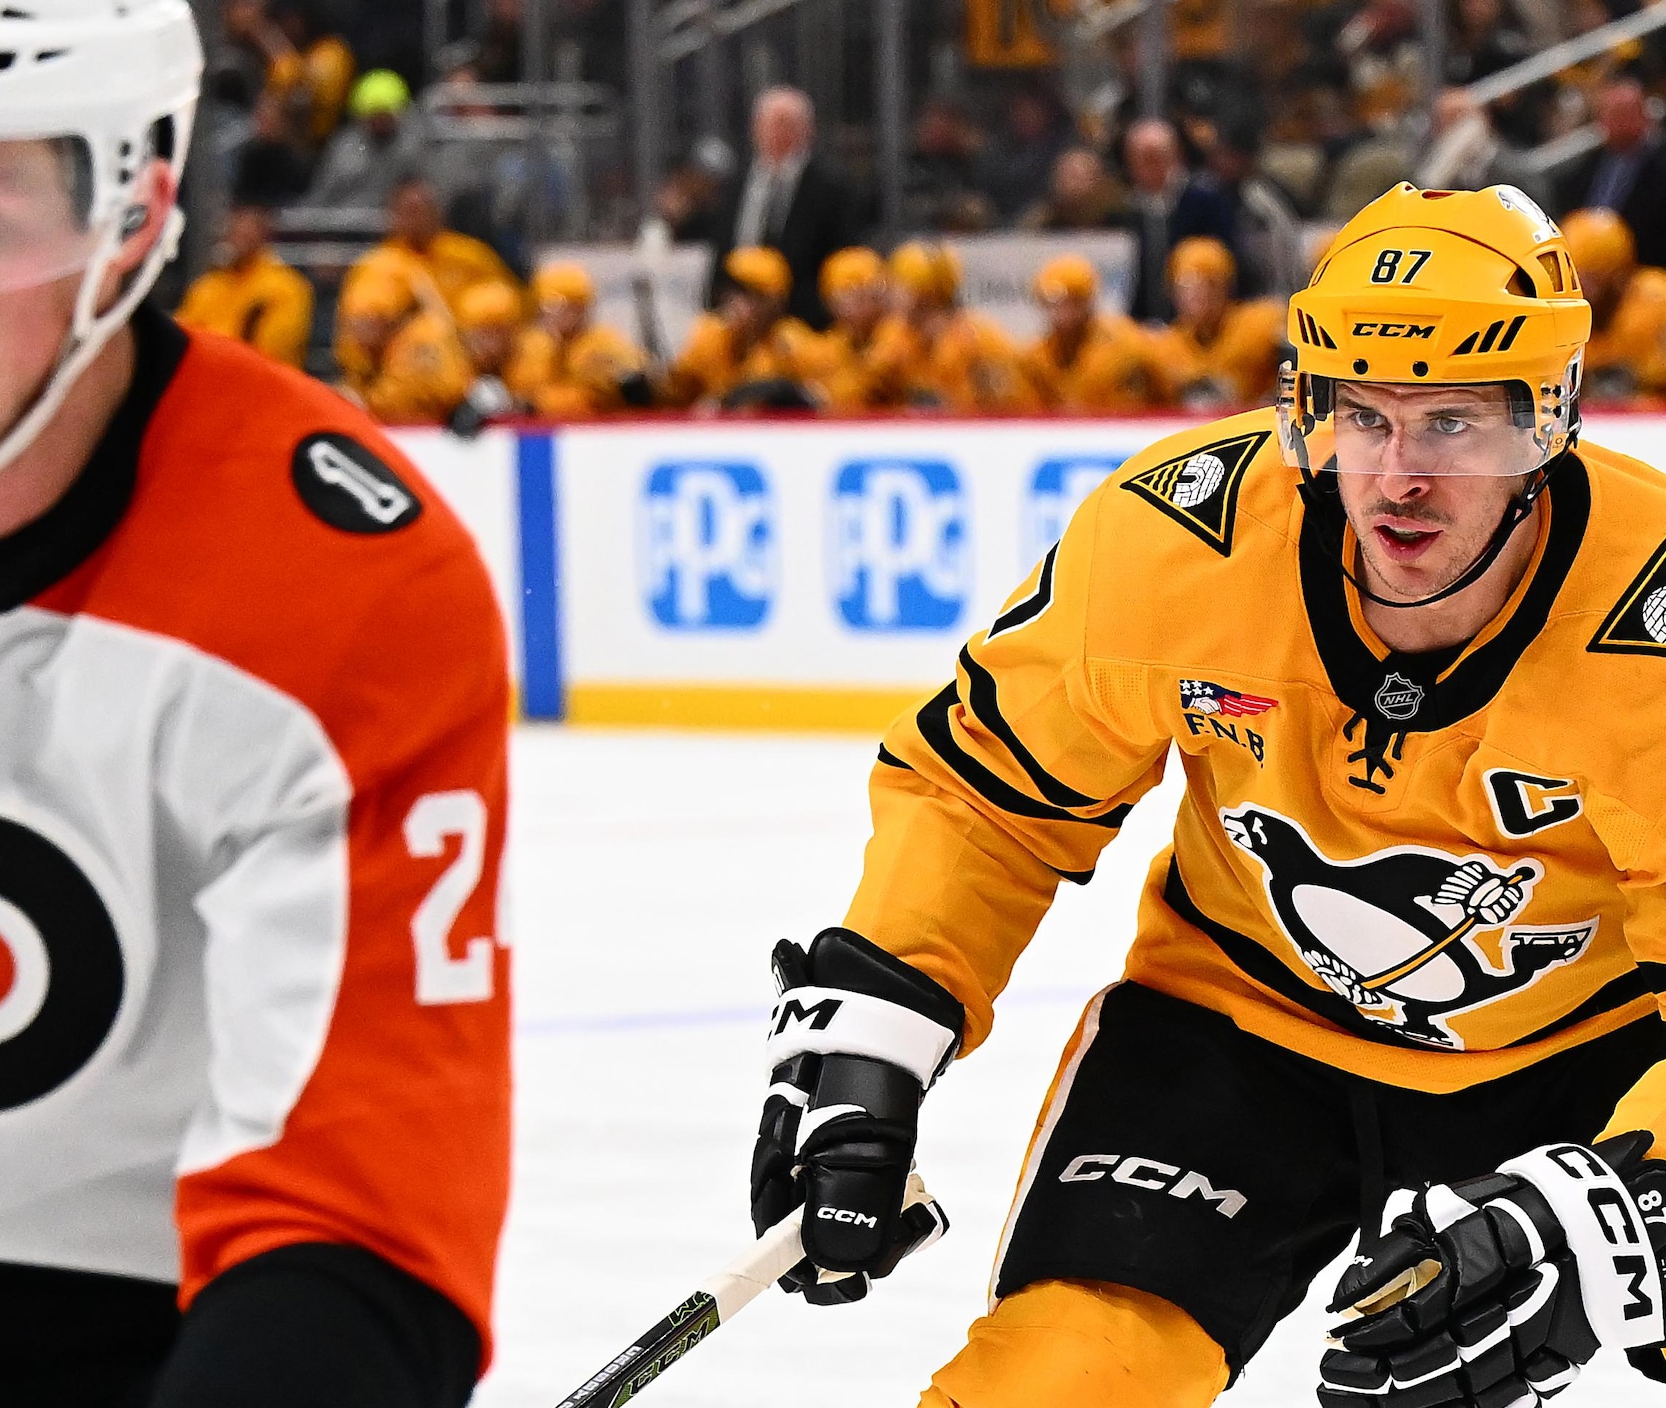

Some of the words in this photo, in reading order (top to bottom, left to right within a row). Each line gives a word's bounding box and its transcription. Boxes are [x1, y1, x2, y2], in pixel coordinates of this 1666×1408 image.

[1370, 248, 1434, 286] 87
[1350, 322, 1436, 339] CCM
[307, 440, 411, 525] 1
[1382, 693, 1415, 706] NHL
[1483, 768, 1585, 839] C
[401, 788, 513, 1007] 2
[815, 1205, 878, 1229] CCM
[1057, 1153, 1248, 1219] CCM
[1546, 1145, 1654, 1322] CCM
[629, 1317, 710, 1397] CCM
